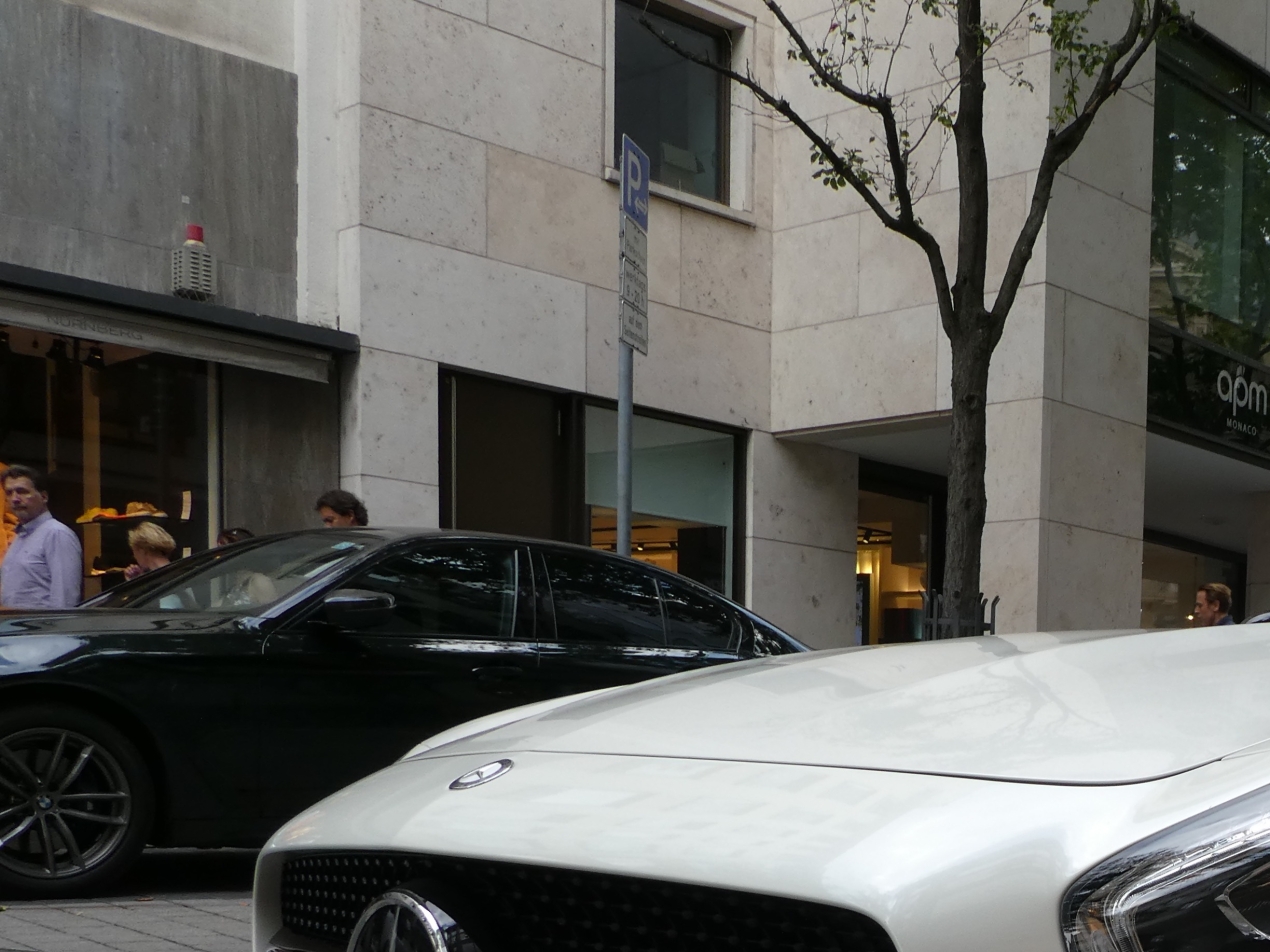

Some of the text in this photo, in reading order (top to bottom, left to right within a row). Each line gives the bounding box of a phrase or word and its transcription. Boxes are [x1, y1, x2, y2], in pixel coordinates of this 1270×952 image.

[627, 149, 642, 207] P
[1216, 368, 1268, 417] apm
[1226, 417, 1257, 436] MONACO
